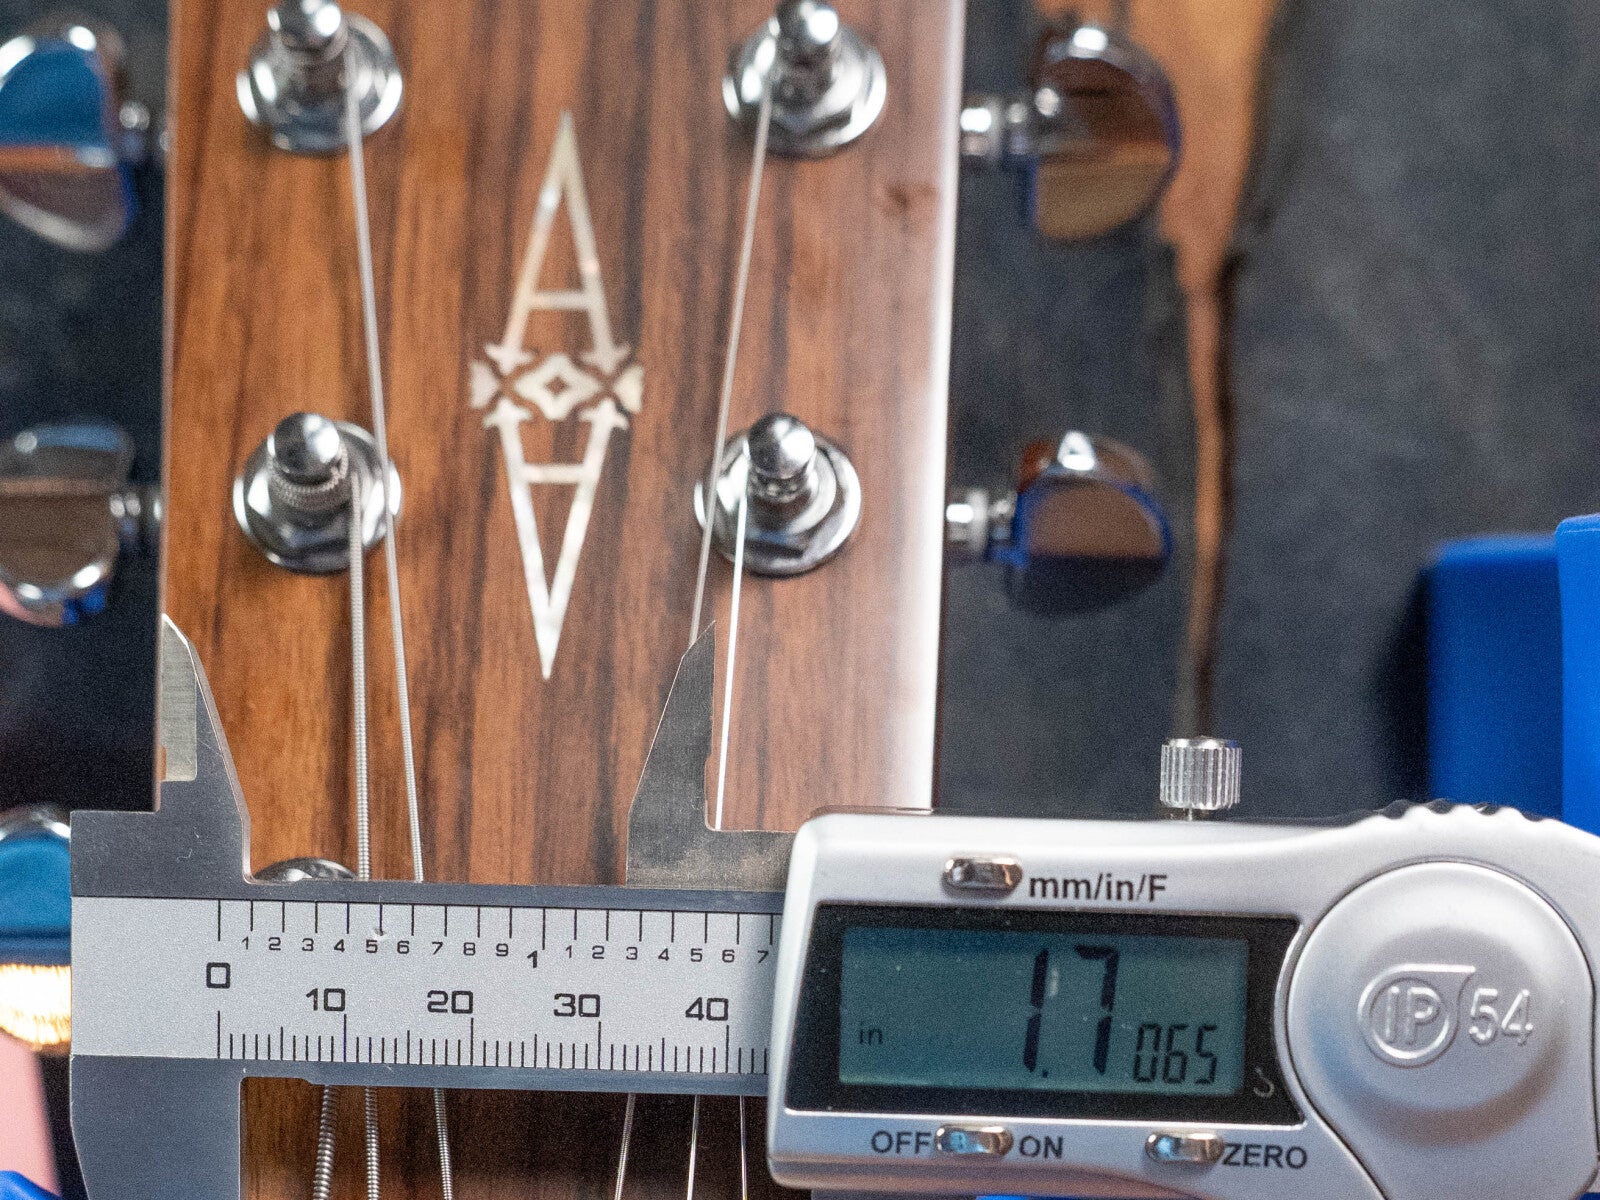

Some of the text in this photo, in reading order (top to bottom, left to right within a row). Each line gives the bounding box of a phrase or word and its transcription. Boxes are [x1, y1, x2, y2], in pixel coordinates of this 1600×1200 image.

[1029, 874, 1168, 902] mm/in/F
[241, 937, 769, 968] 1 2 3 4 5 6 7 8 9 1 1 2 3 4 5 6 7
[206, 962, 231, 989] 0
[305, 988, 729, 1021] 10 20 30 40
[1384, 985, 1535, 1046] IP 54
[858, 1022, 884, 1046] in
[871, 1130, 1064, 1159] OFF ON
[1222, 1144, 1308, 1170] ZERO
